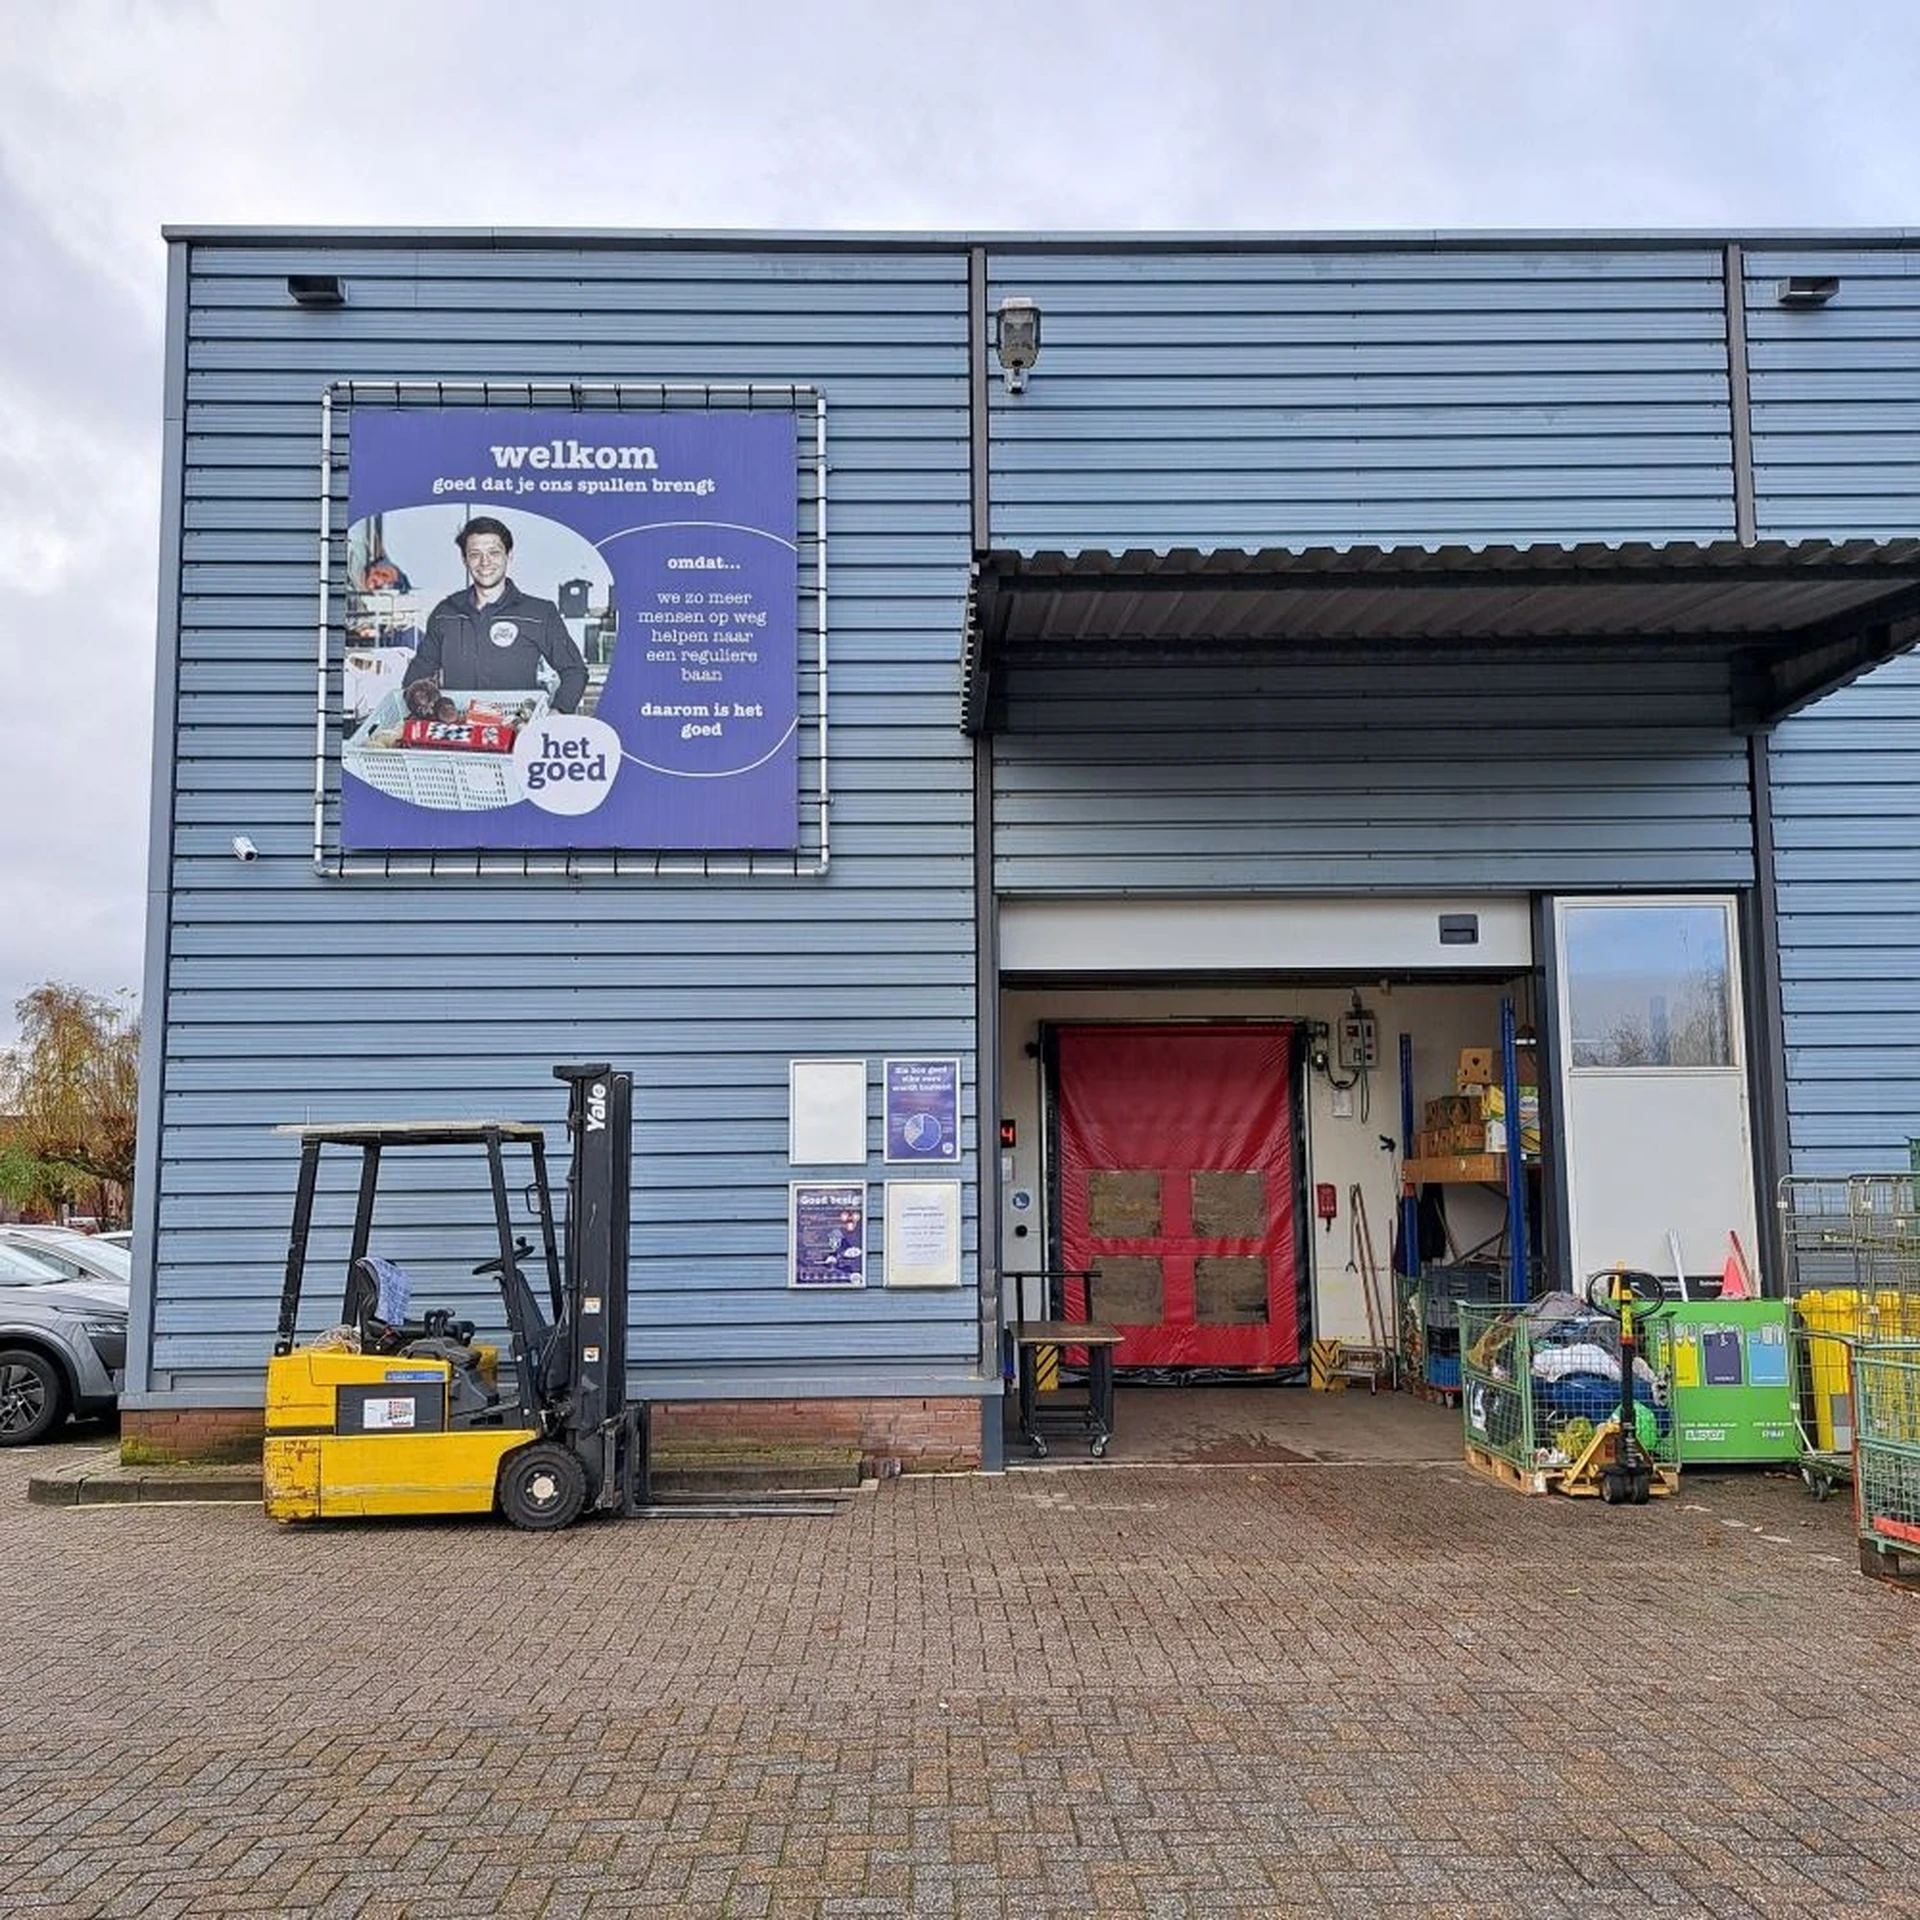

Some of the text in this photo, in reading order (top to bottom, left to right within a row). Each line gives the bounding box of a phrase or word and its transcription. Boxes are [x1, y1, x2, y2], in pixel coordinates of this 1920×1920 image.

[490, 440, 658, 469] welkom
[432, 477, 716, 495] goed dat je ons spullen brengt
[667, 556, 741, 569] omdat...
[657, 592, 752, 604] we zo meer
[637, 611, 767, 626] mensen op weg
[651, 629, 753, 645] helpen naar
[646, 648, 758, 664] een reguliere
[680, 667, 723, 681] baan
[641, 702, 763, 717] daarom is het
[680, 722, 723, 739] goed
[540, 733, 591, 759] het
[527, 755, 607, 789] goed
[586, 1083, 606, 1132] Yale
